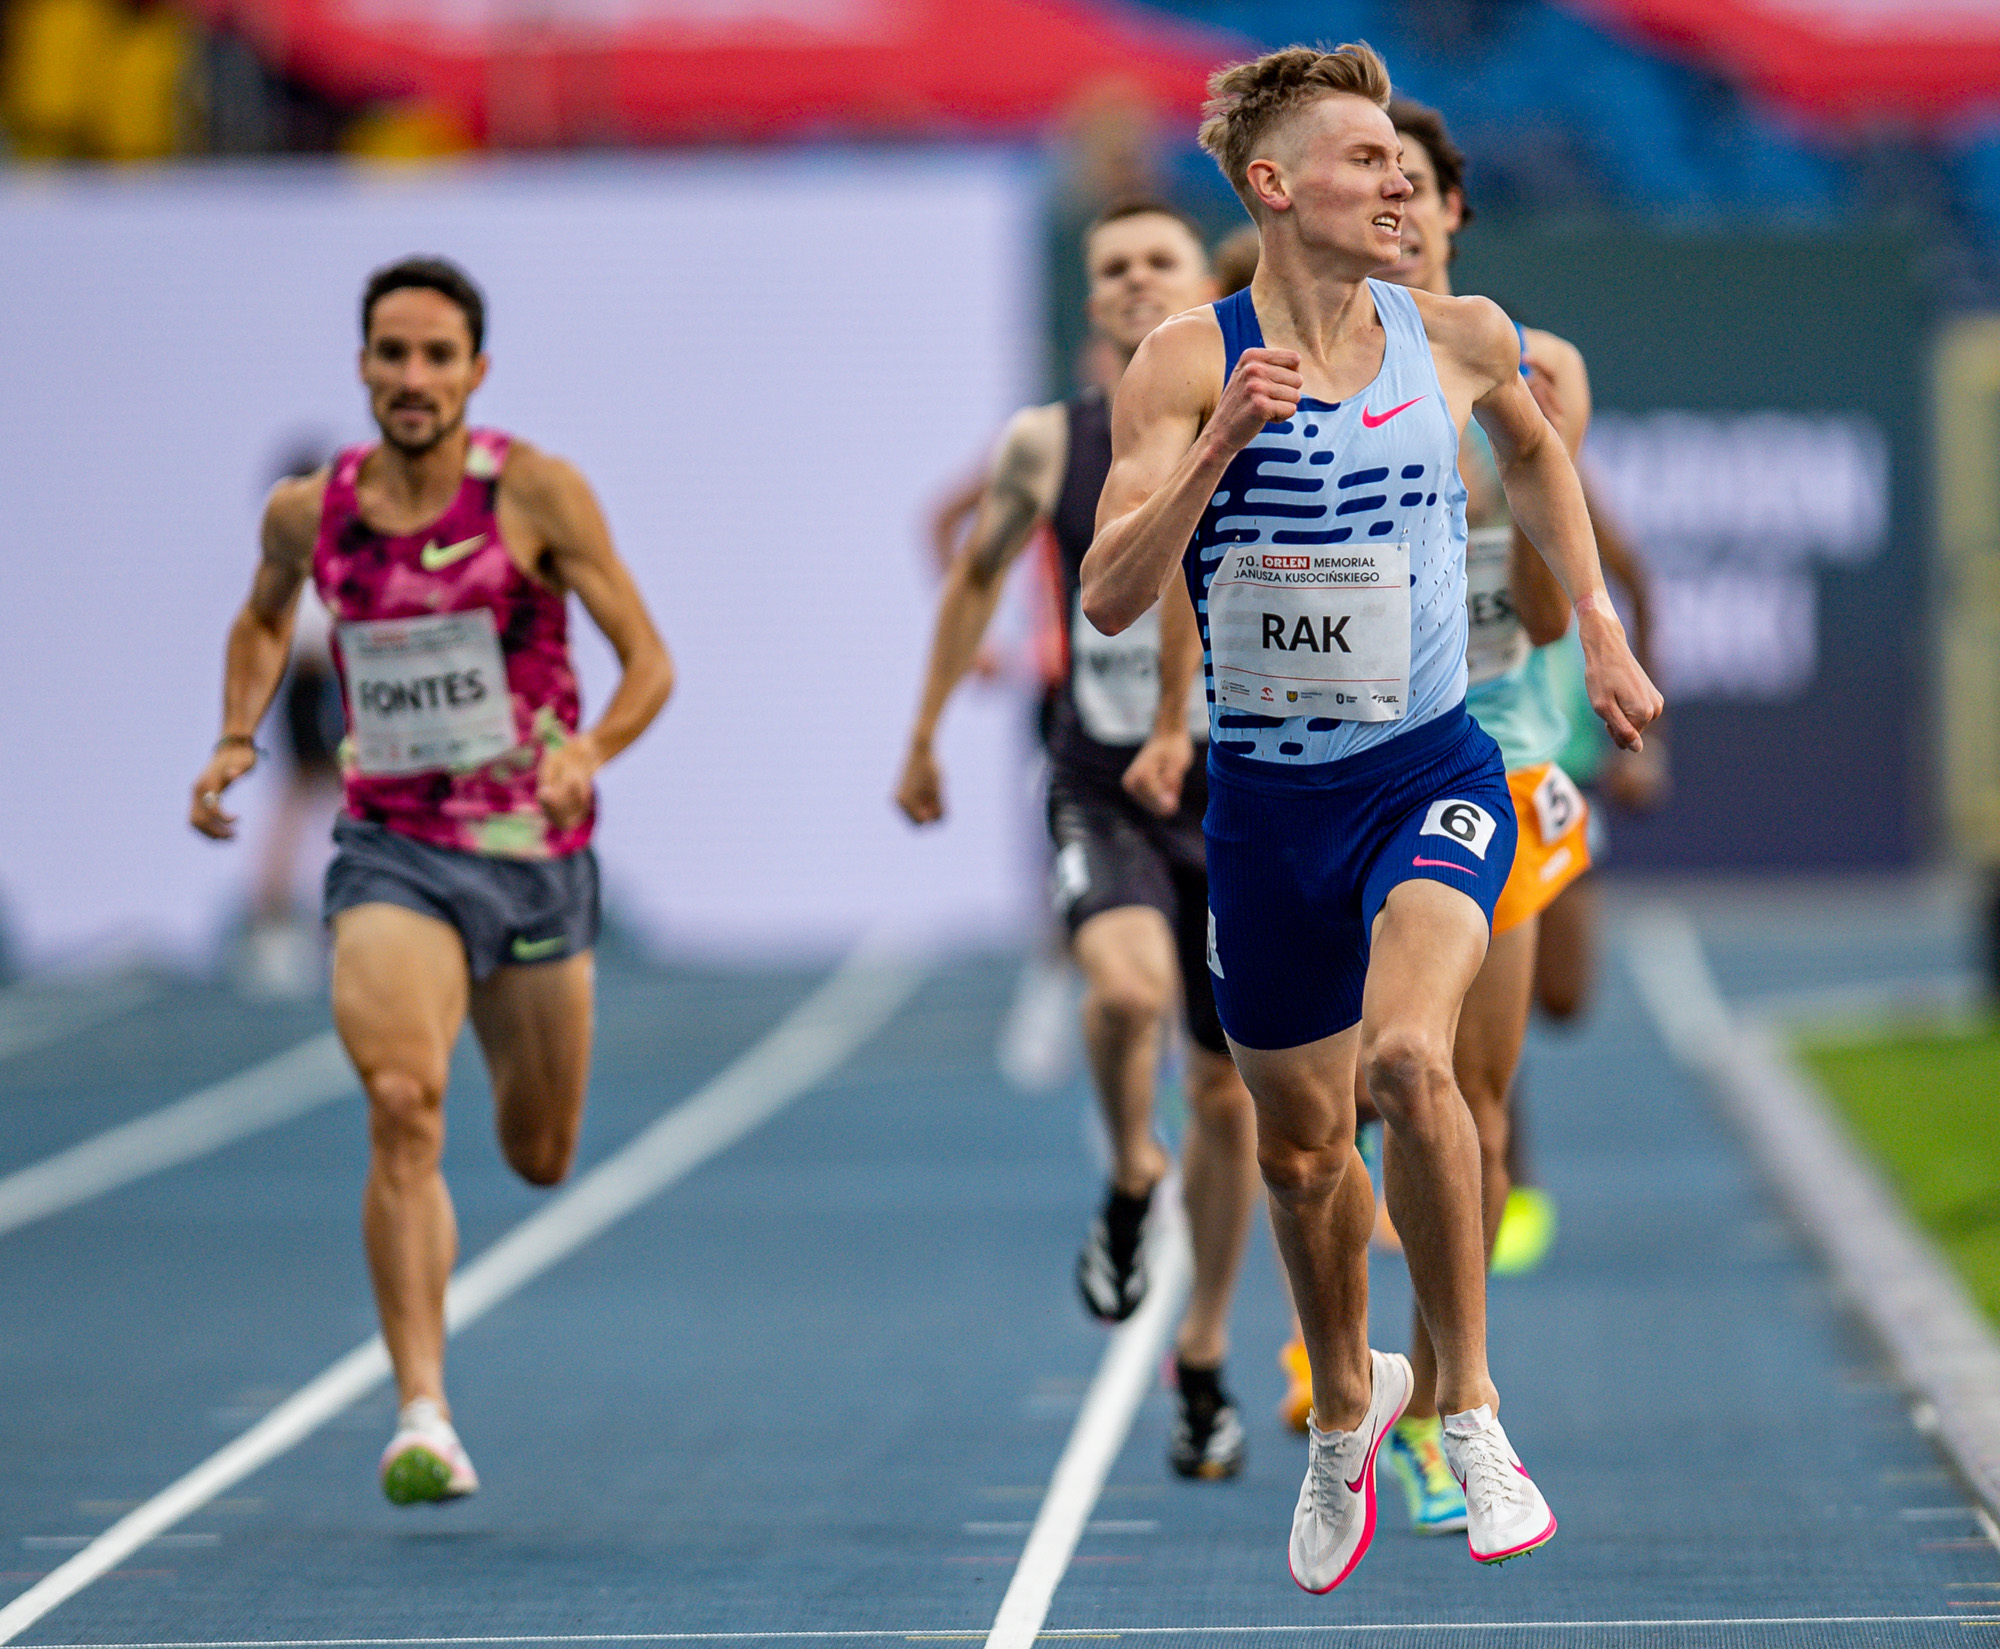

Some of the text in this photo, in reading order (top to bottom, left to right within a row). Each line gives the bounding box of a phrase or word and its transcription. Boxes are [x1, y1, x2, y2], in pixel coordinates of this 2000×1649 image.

[1234, 570, 1380, 583] JANUSZA KUSOCIŃSKIEGO
[1236, 555, 1376, 569] 70. ORLEN MEMORIAŁ
[1262, 612, 1353, 653] RAK
[359, 667, 487, 719] FONTES
[1547, 778, 1572, 828] 5
[1440, 804, 1481, 842] 6
